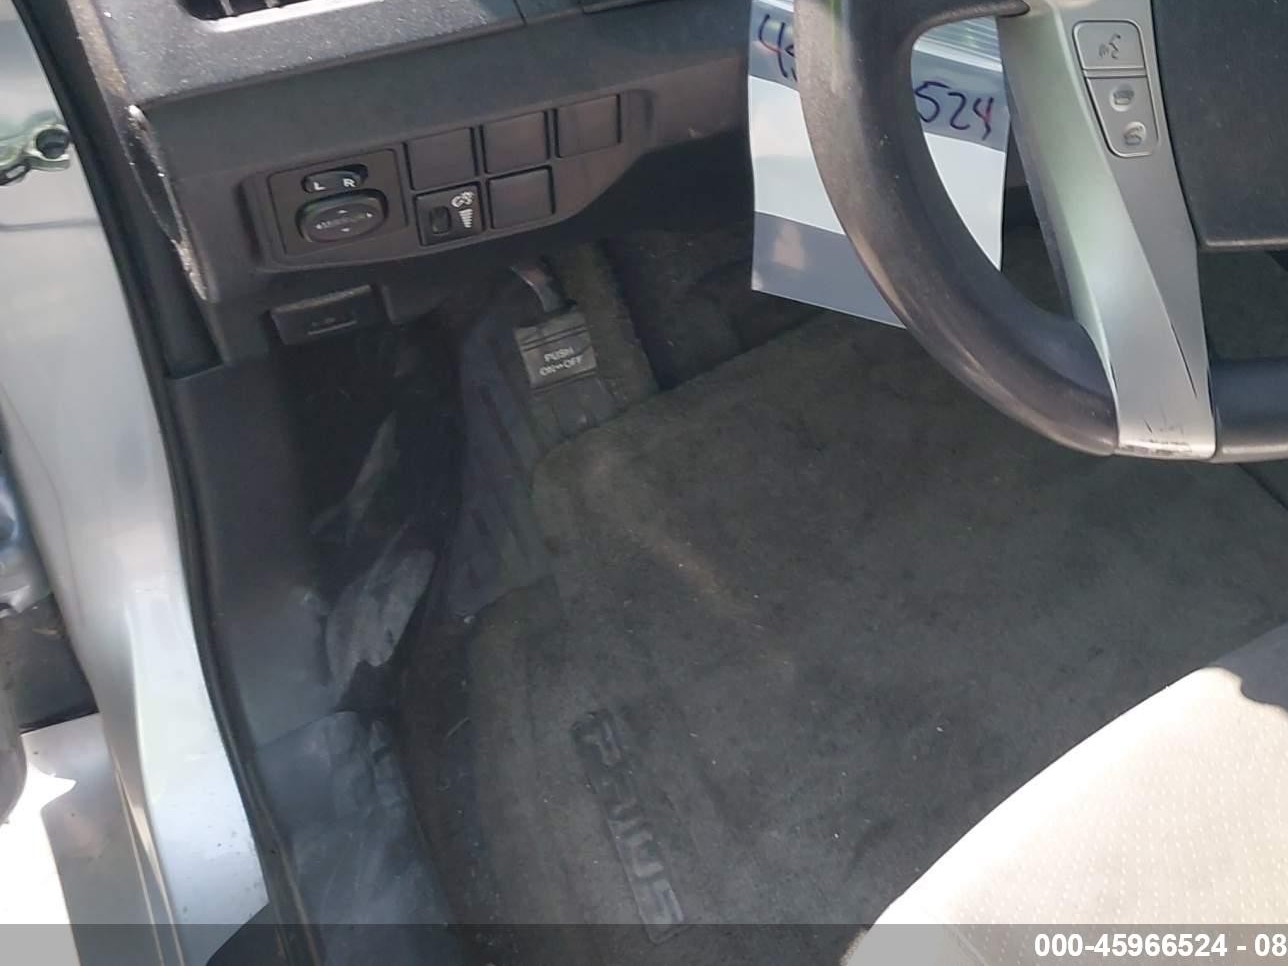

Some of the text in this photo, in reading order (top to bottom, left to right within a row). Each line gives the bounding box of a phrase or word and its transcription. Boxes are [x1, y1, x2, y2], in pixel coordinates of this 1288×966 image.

[914, 81, 995, 140] 524
[313, 177, 357, 191] L R
